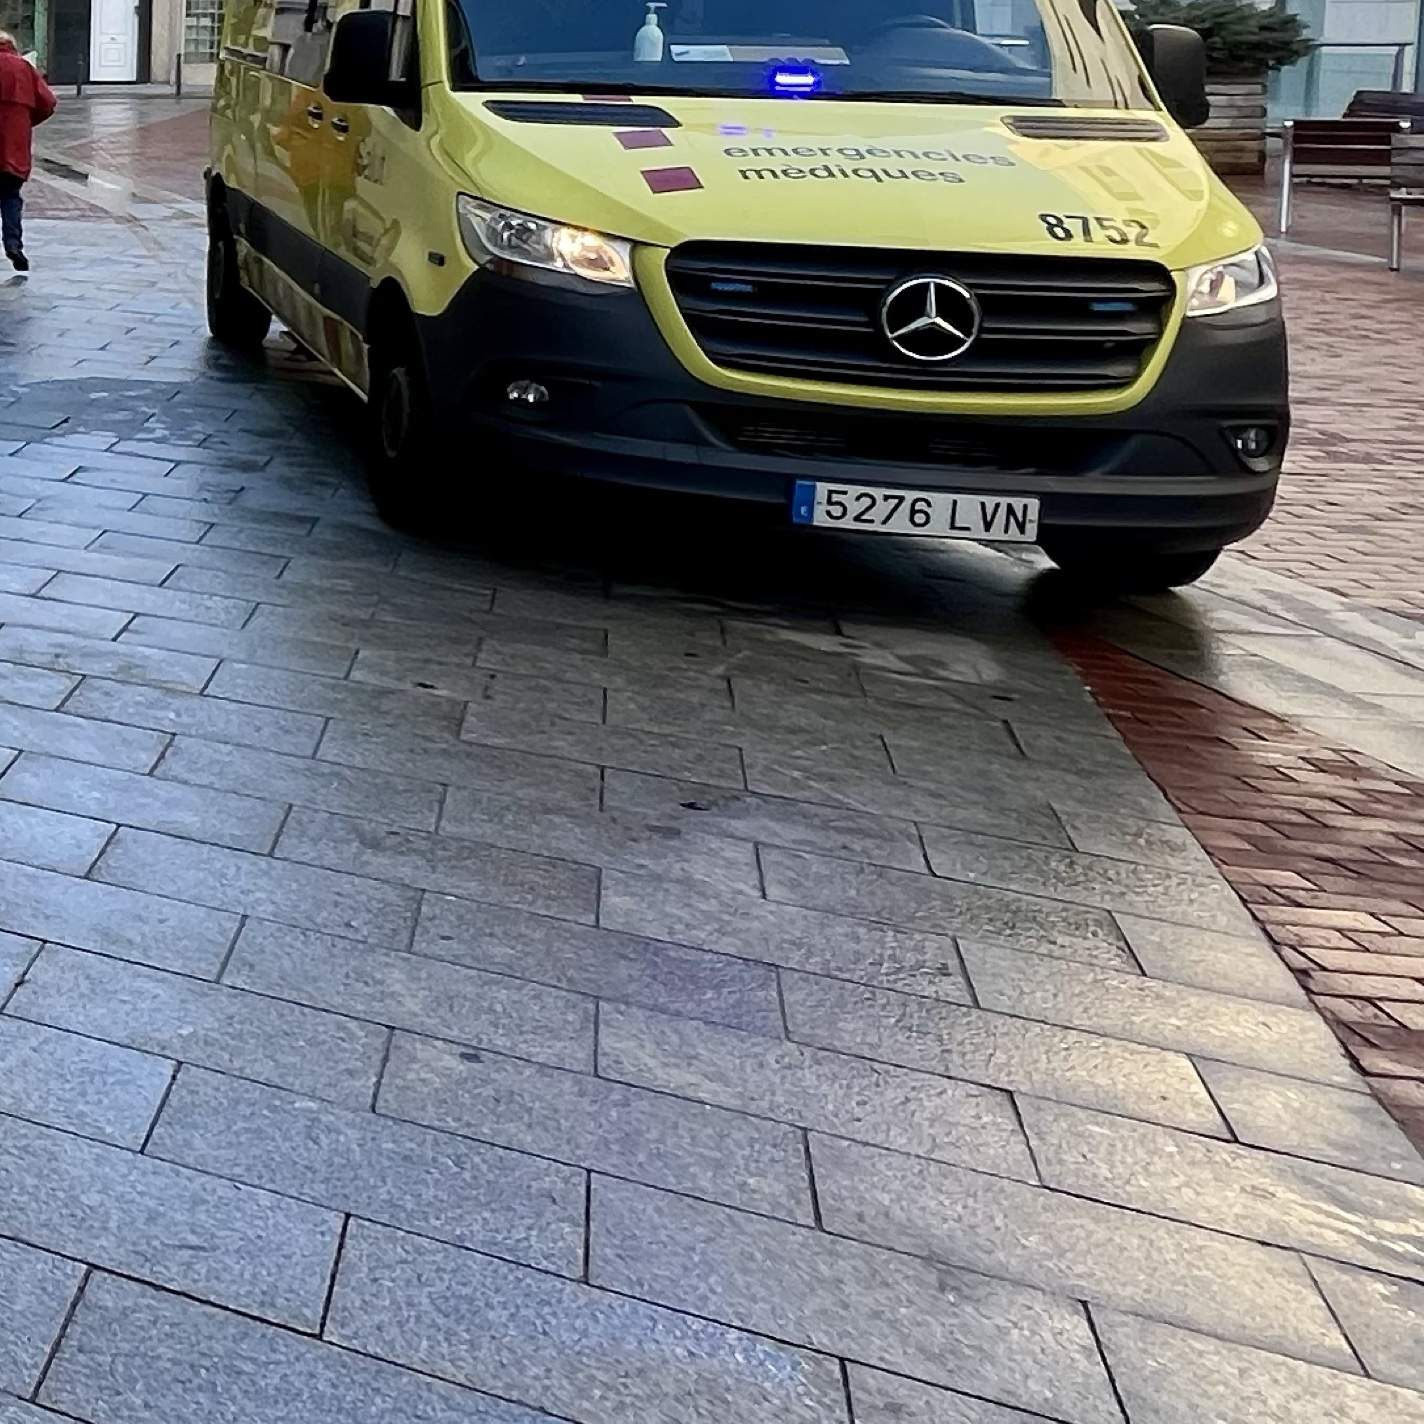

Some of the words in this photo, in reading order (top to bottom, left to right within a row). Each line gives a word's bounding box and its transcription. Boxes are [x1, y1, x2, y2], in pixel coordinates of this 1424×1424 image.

[722, 143, 1016, 168] emergències
[737, 163, 965, 185] mèdiques
[1037, 212, 1160, 249] 8752
[824, 488, 933, 528] 5276
[948, 498, 1029, 536] LVN
